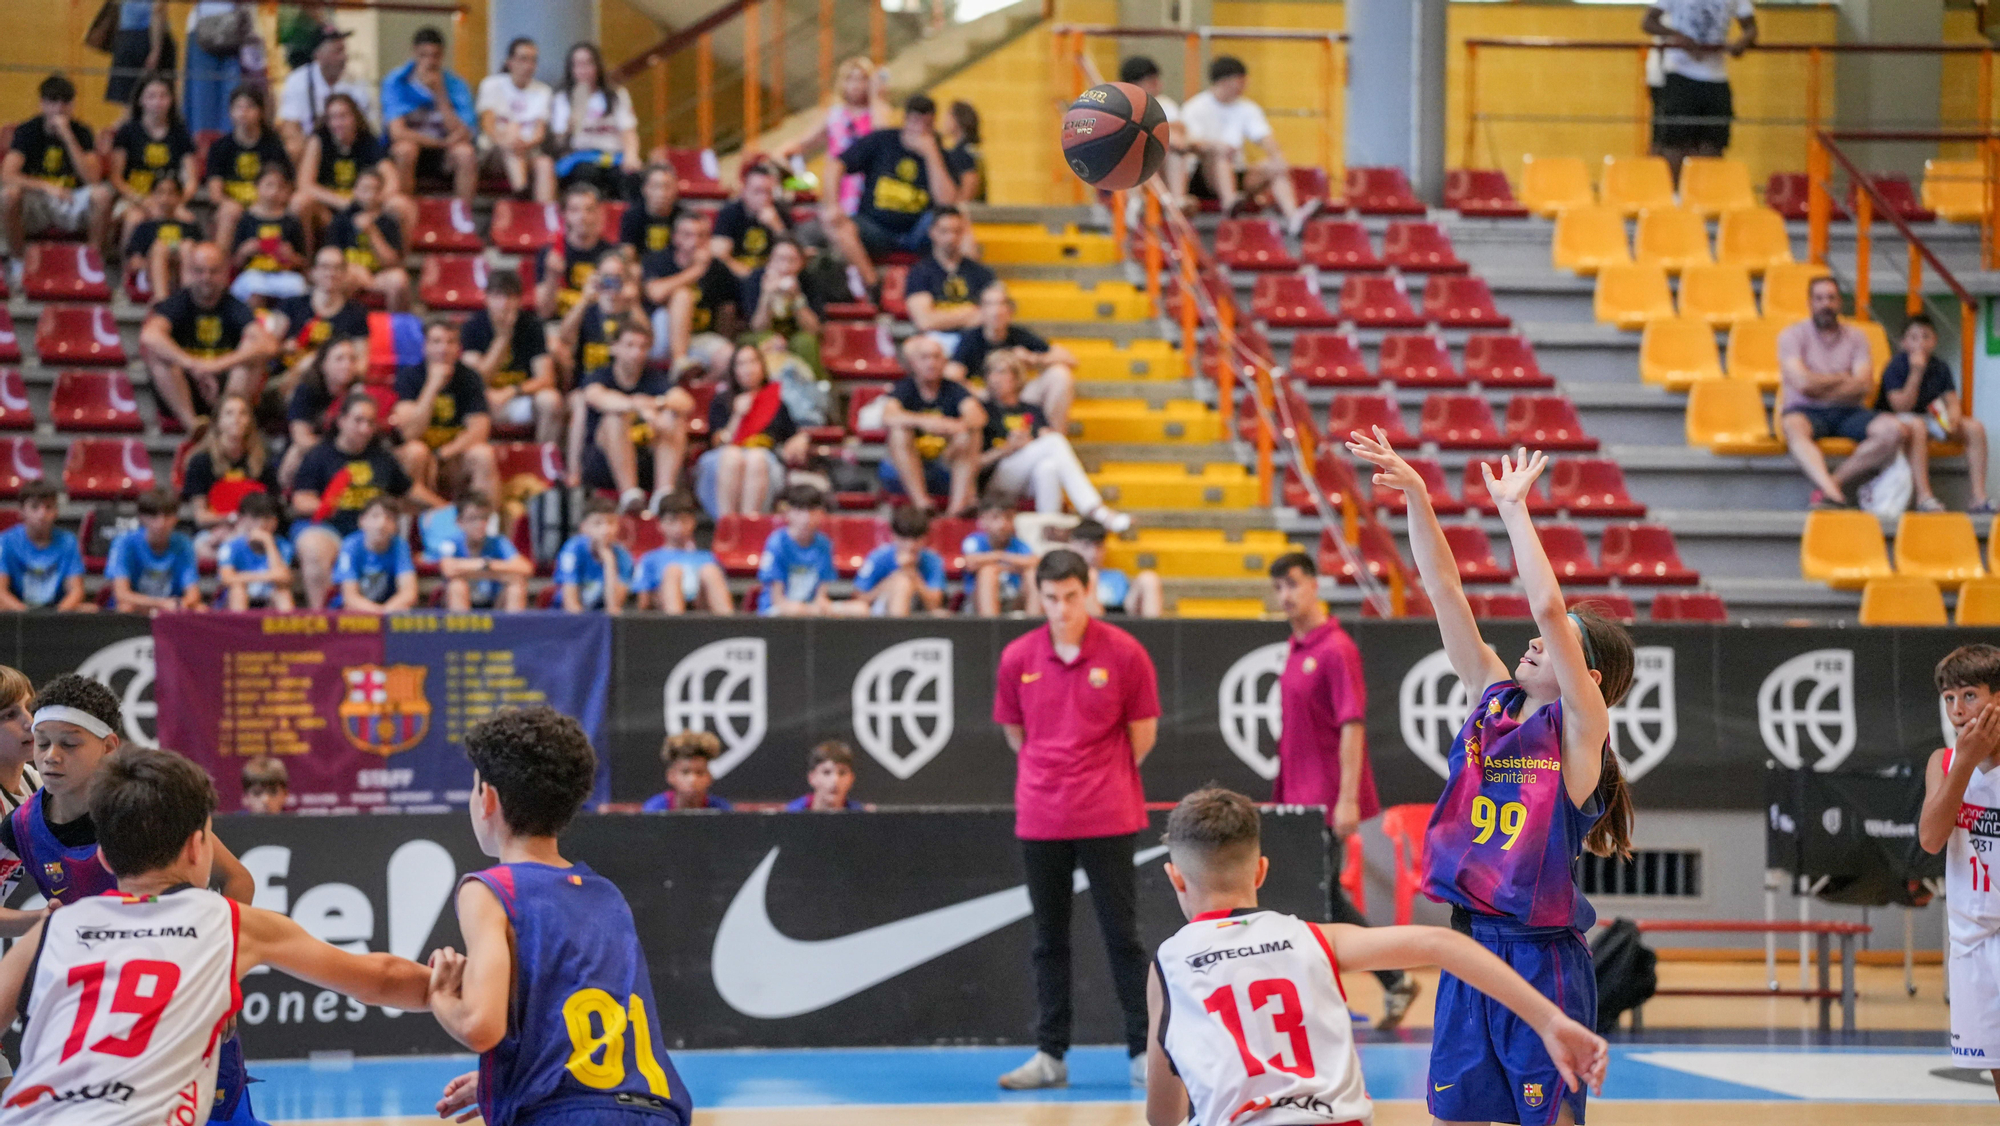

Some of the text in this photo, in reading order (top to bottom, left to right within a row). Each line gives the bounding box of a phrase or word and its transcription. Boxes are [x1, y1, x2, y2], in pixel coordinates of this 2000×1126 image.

[1484, 755, 1561, 771] Assistència
[1485, 769, 1537, 784] Sanitària
[1471, 795, 1528, 851] 99
[1969, 838, 1993, 852] 031
[59, 958, 181, 1066] 19
[1203, 977, 1316, 1079] 13
[561, 987, 672, 1100] 81
